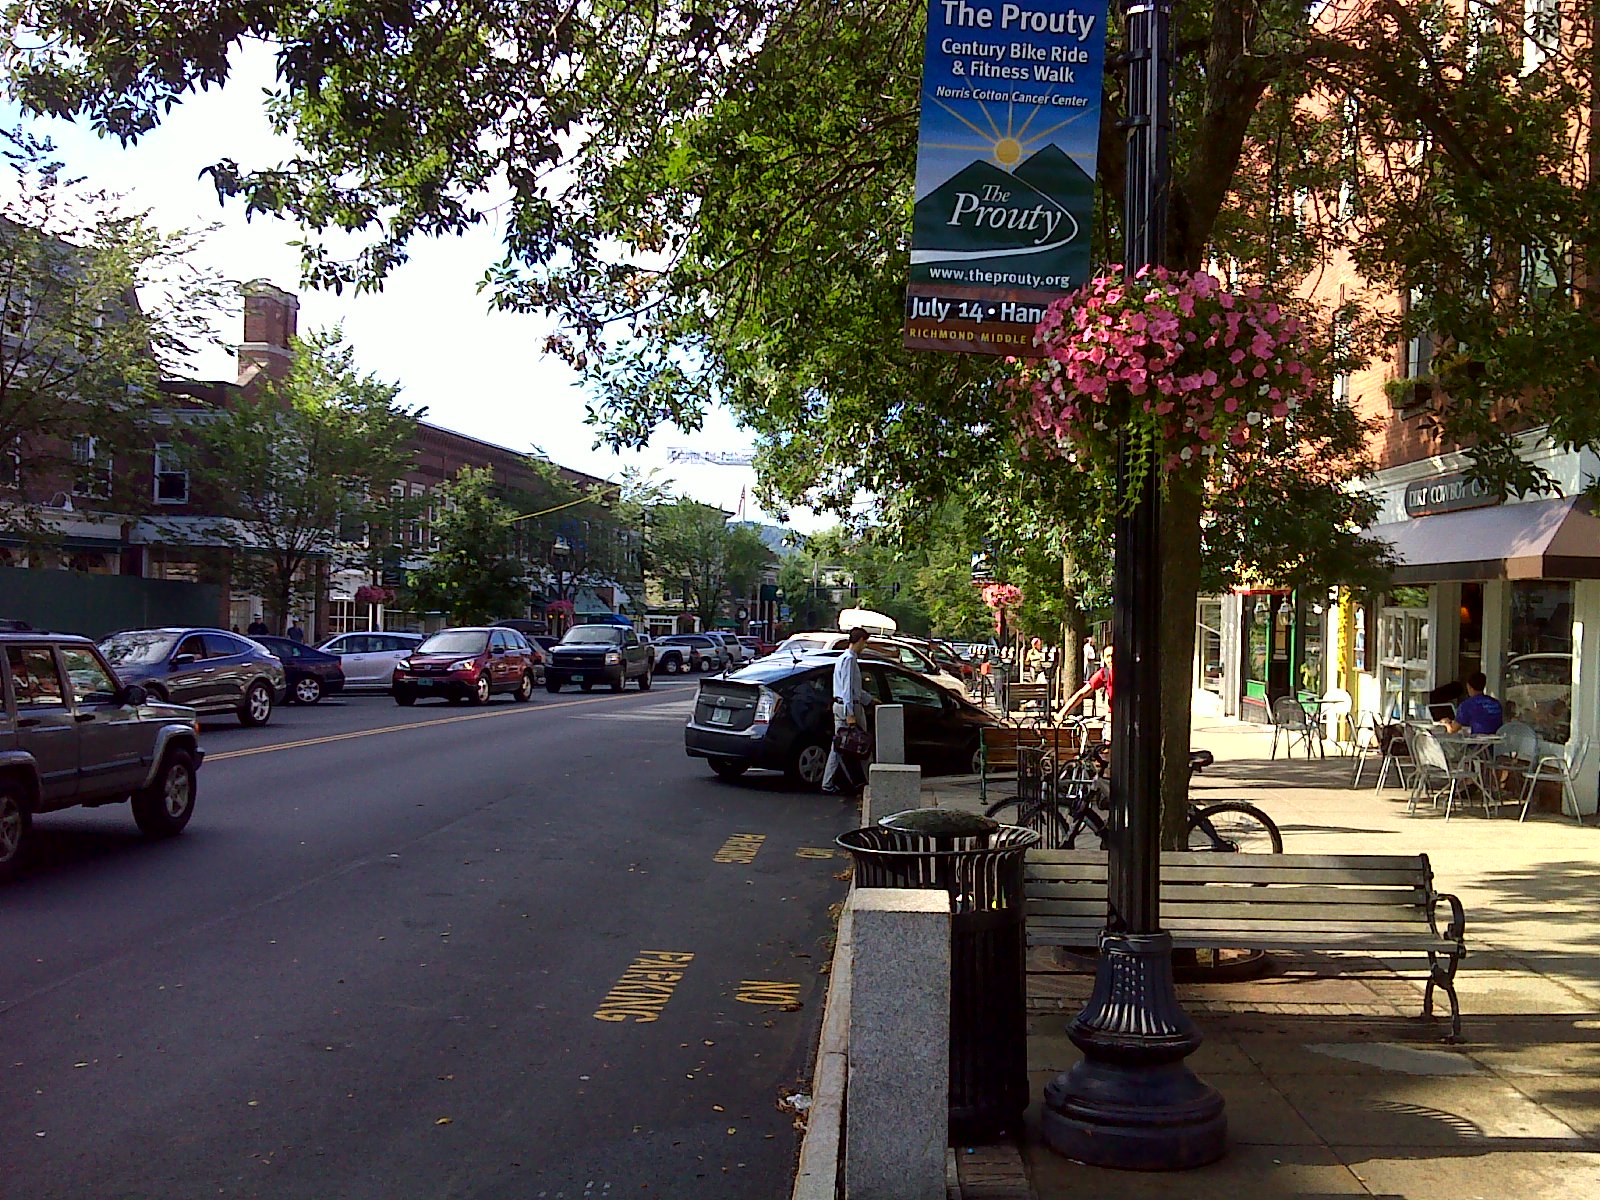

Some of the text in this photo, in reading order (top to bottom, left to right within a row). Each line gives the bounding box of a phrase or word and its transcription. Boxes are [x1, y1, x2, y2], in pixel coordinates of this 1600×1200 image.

[941, 0, 1095, 41] The Prouty
[941, 38, 1088, 63] Century Bike Ride
[952, 60, 1075, 83] & Fitness Walk
[936, 86, 1088, 107] Norris Cotton Cancer Center
[982, 184, 1011, 203] The
[946, 192, 1062, 245] Prouty
[929, 267, 1071, 289] www.theprouty.org
[910, 297, 951, 323] July
[958, 302, 984, 323] 14
[909, 327, 1027, 345] RICHMOND MIDDLE
[1409, 487, 1428, 507] DIRT
[1431, 481, 1466, 504] COWBOY
[593, 950, 695, 1022] PARKING
[733, 980, 800, 1005] NO
